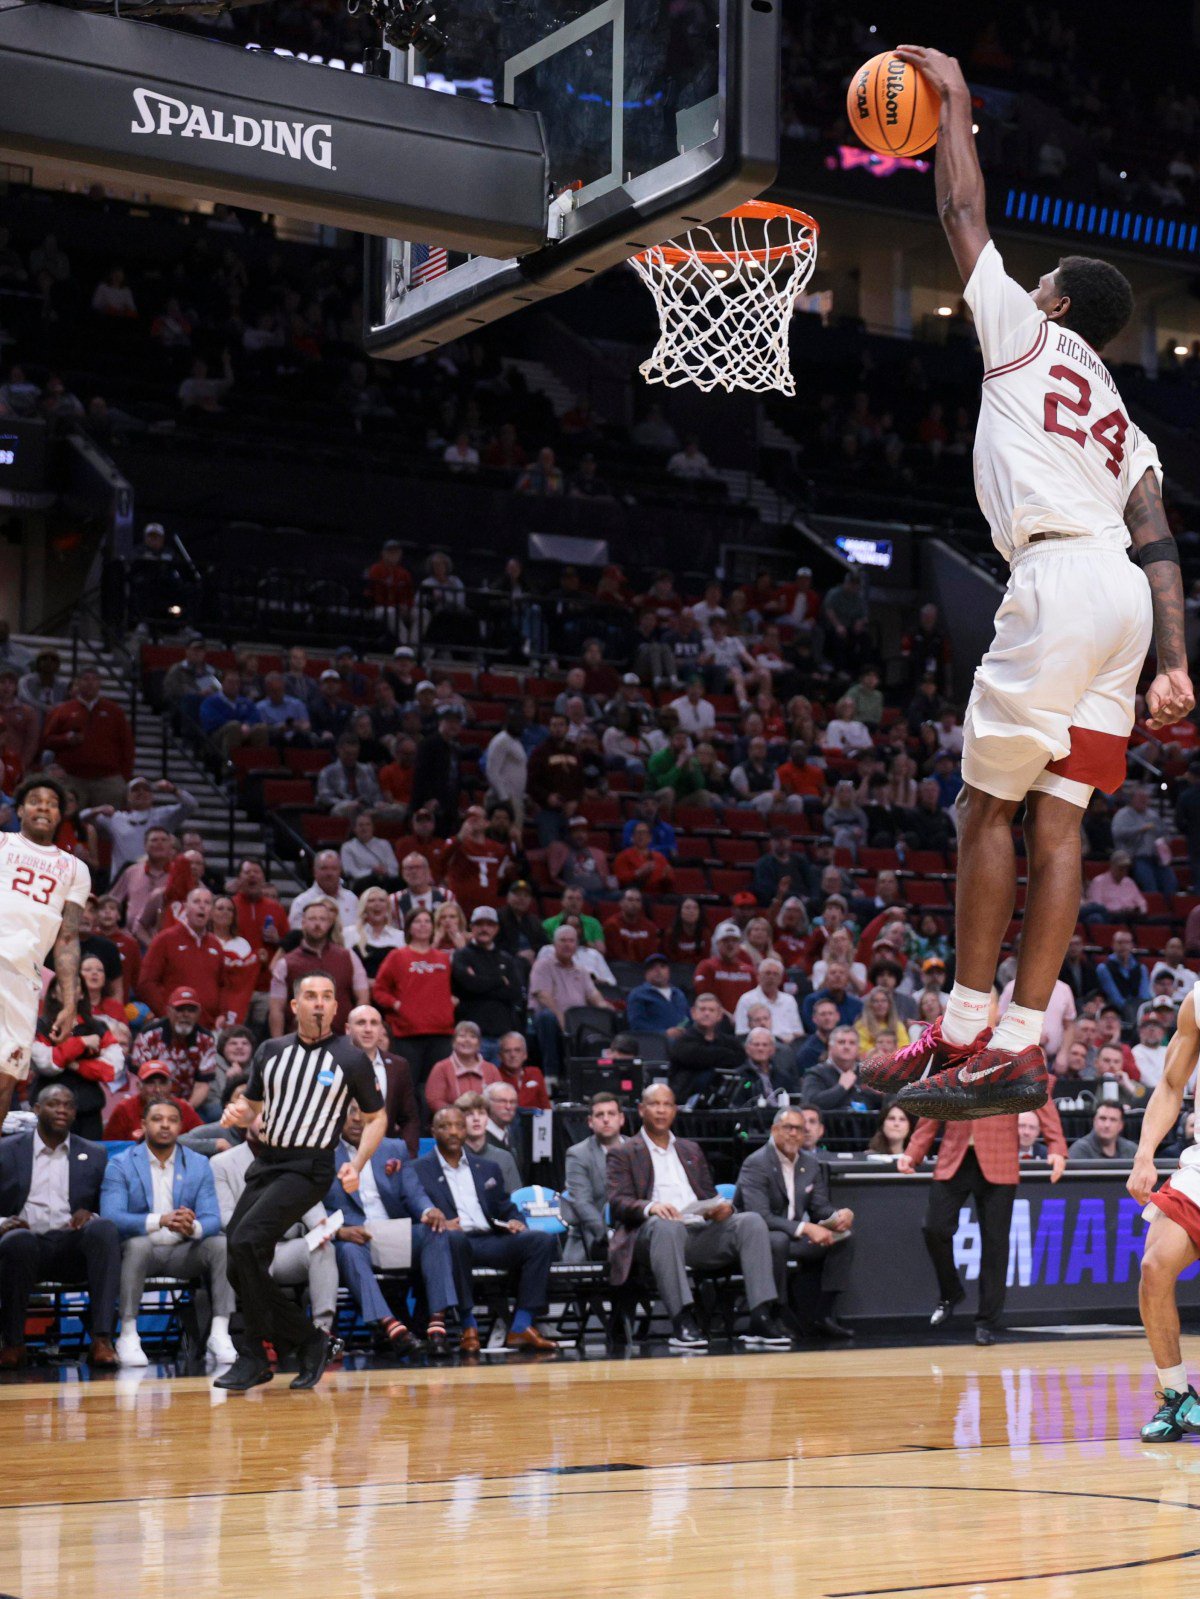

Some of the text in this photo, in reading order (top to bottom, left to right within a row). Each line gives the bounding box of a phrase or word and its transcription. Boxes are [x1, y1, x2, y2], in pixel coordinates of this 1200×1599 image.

[856, 70, 871, 120] NCAA
[886, 59, 906, 126] Wilson
[131, 87, 333, 170] SPALDING
[1044, 364, 1129, 480] 24
[12, 866, 57, 906] 23
